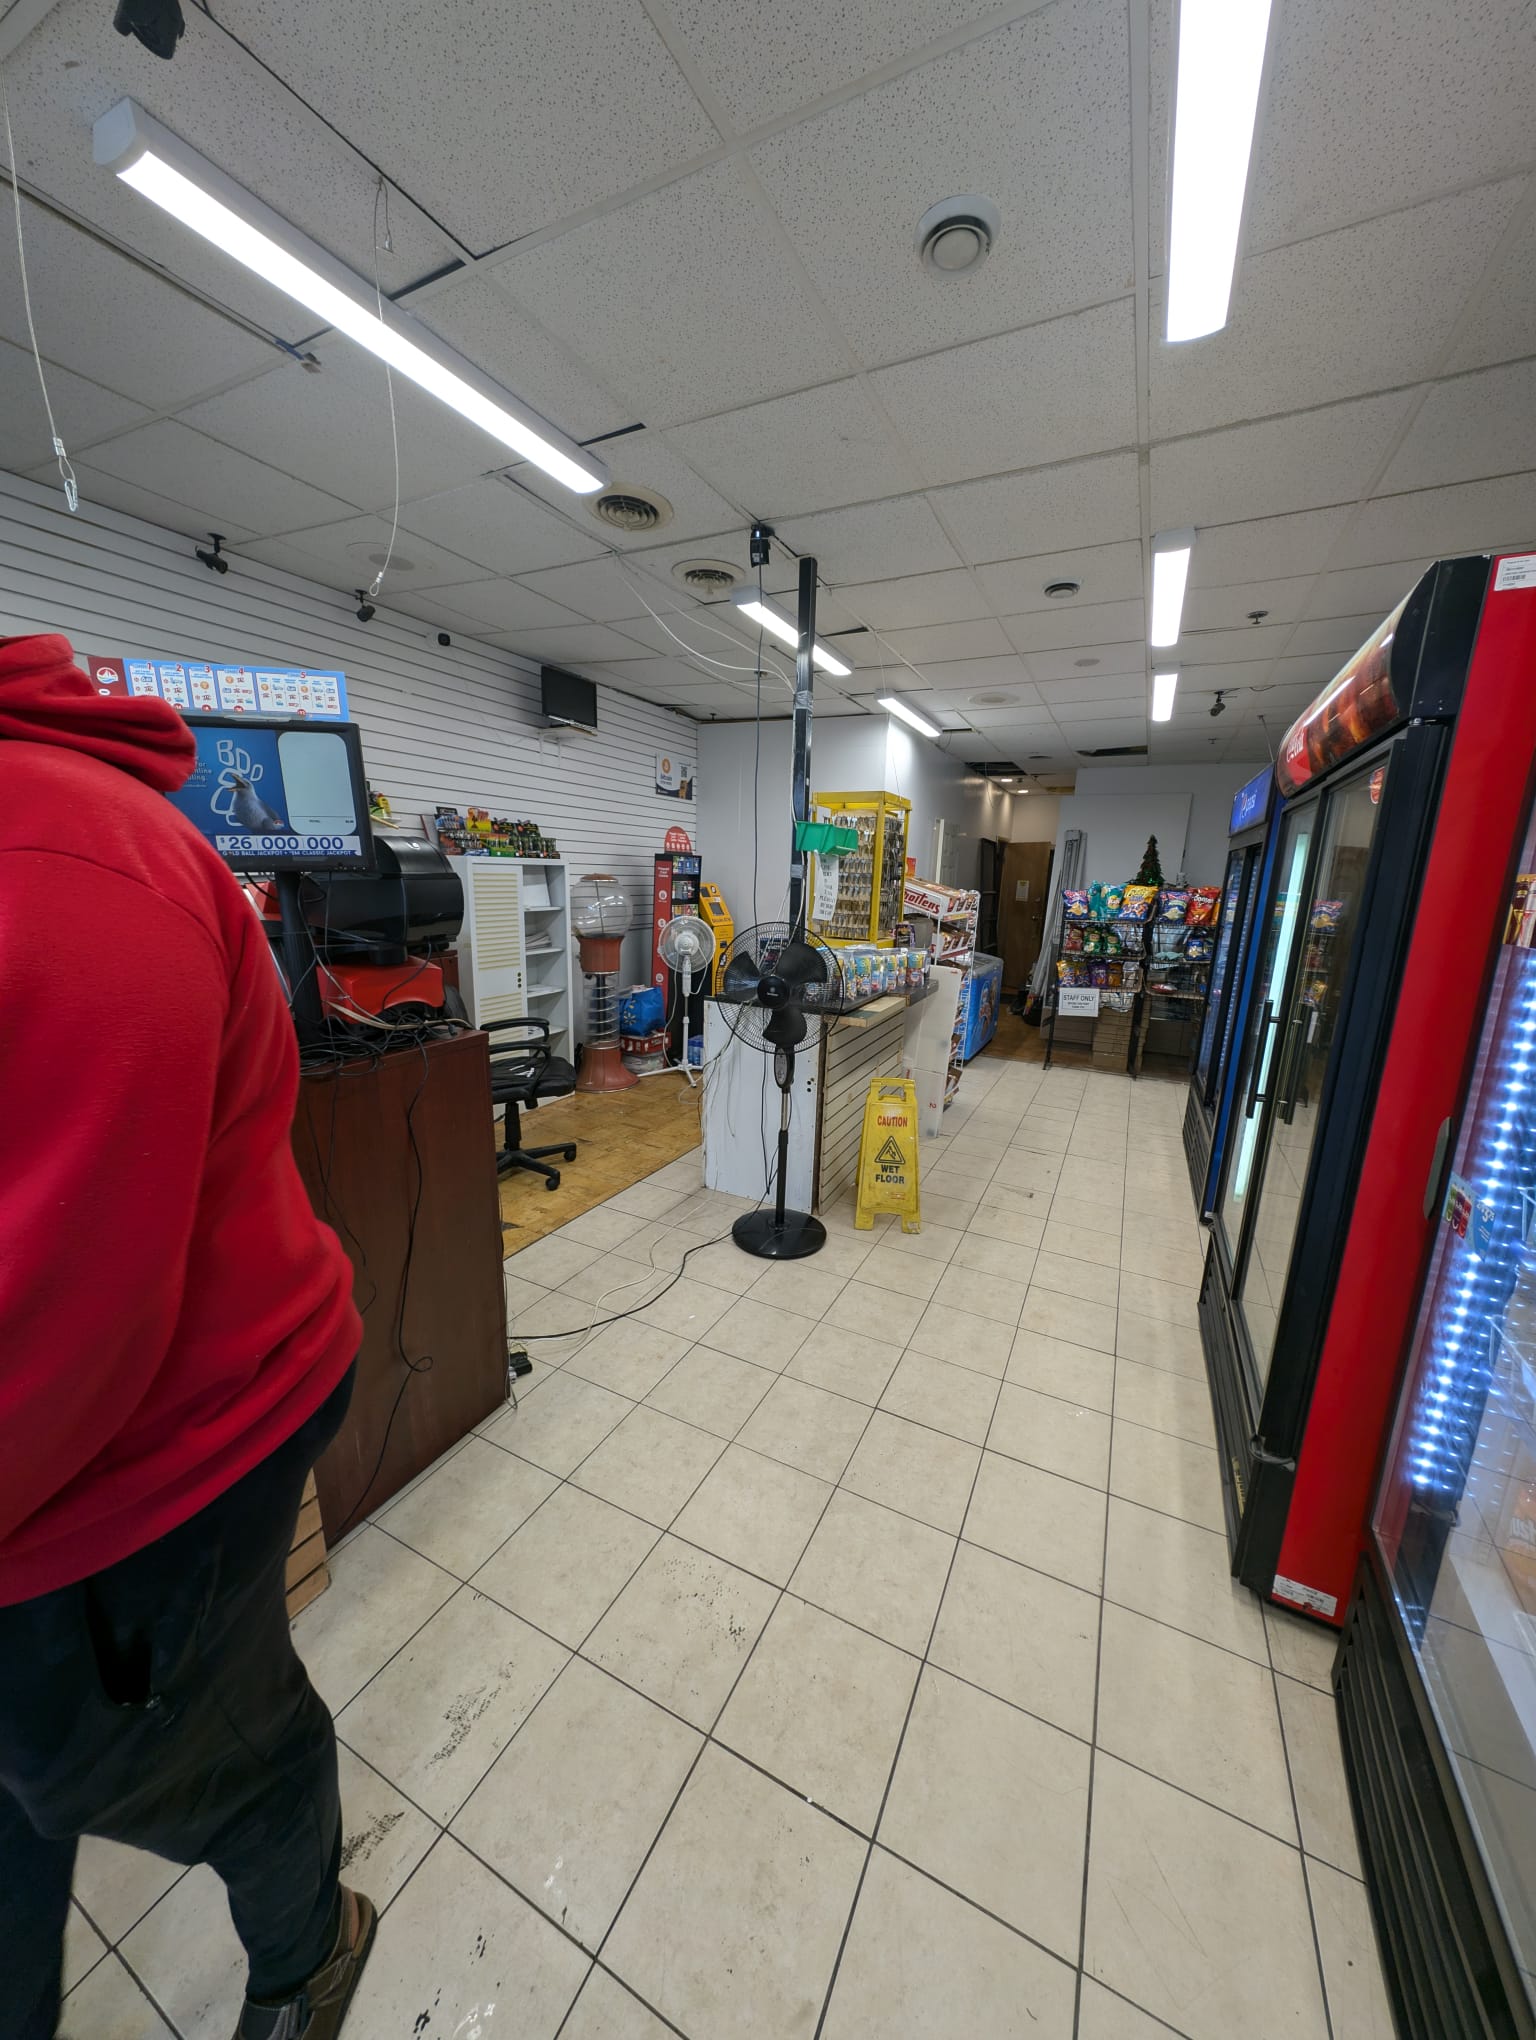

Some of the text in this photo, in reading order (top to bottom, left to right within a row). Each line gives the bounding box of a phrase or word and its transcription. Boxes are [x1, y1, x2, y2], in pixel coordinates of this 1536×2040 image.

[176, 663, 182, 671] 2
[204, 665, 211, 673] 3
[300, 671, 306, 679] 5
[261, 836, 299, 850] 000
[307, 836, 343, 850] 000
[877, 1115, 908, 1128] CAUTION
[880, 1164, 900, 1174] WET
[875, 1174, 905, 1184] FLOOR
